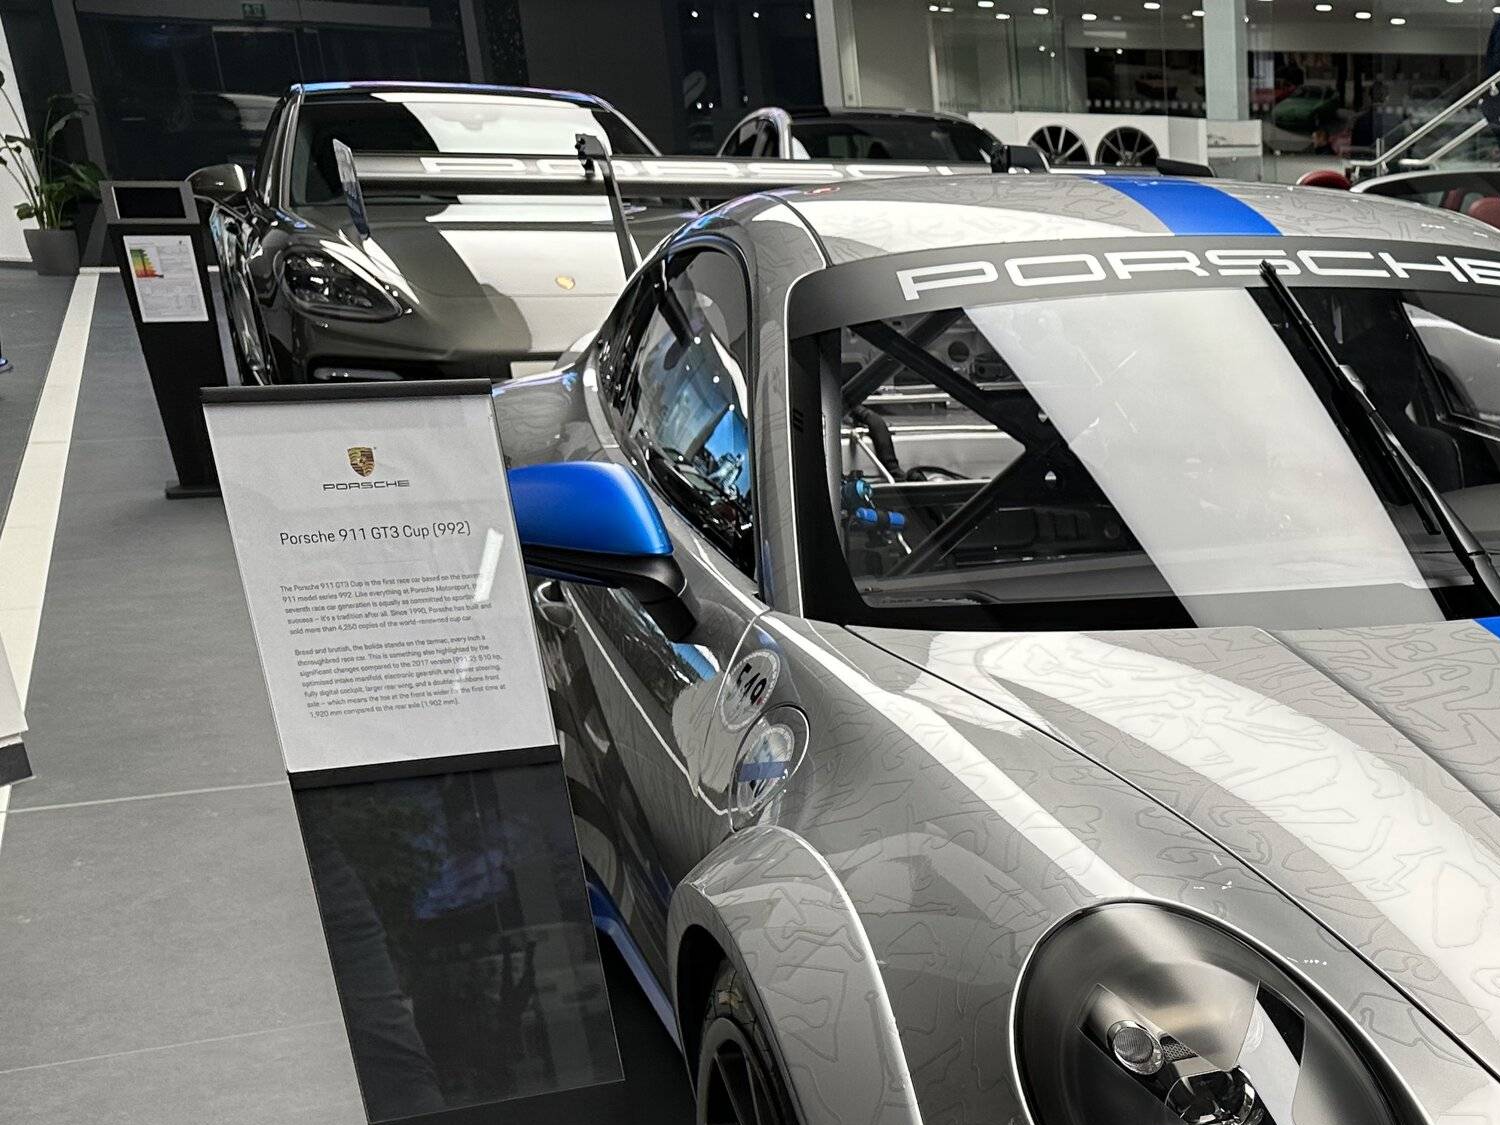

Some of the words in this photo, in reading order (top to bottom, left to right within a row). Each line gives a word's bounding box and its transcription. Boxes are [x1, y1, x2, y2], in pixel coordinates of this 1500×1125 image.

[322, 479, 410, 491] PORSCHE
[279, 531, 336, 546] Porsche
[338, 527, 367, 541] 911
[371, 525, 400, 540] GT3
[402, 524, 430, 540] Cup
[432, 520, 471, 538] (992)
